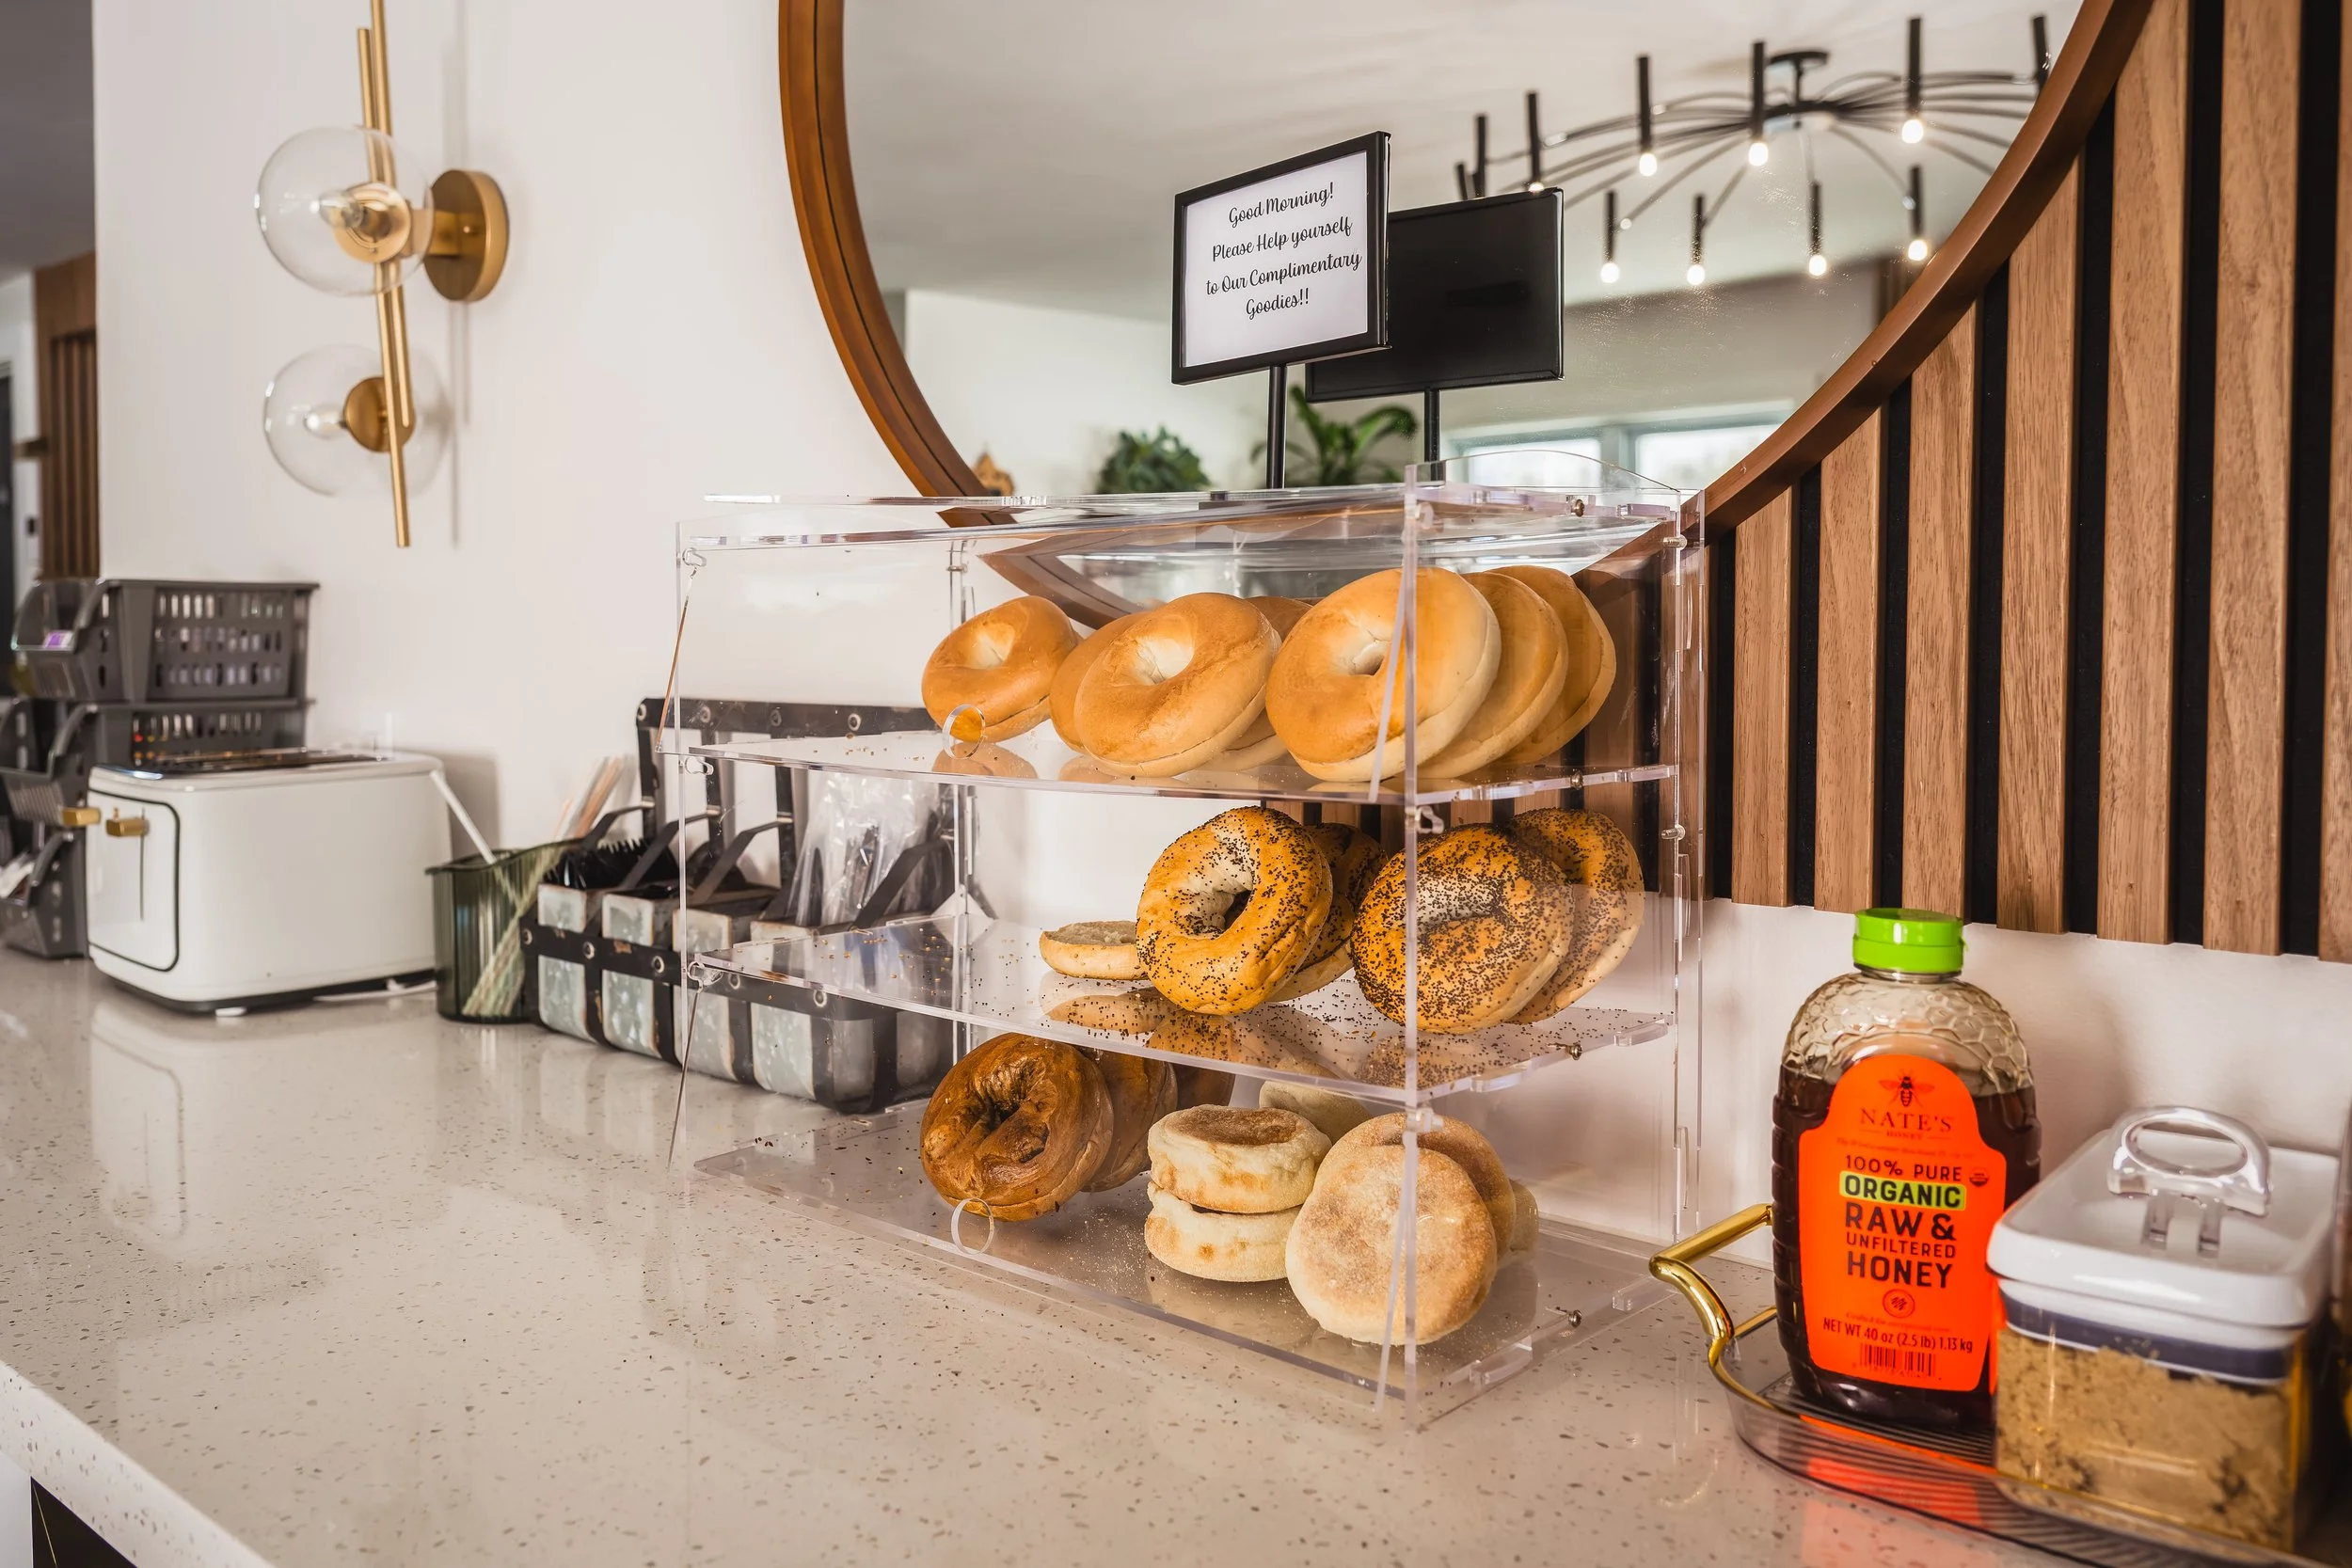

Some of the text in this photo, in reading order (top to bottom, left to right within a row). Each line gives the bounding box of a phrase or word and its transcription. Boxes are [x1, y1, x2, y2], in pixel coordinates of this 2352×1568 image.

[1229, 182, 1334, 229] Good Morning!
[1213, 216, 1353, 262] Please Help yourself
[1206, 250, 1362, 295] to Our Complimentary
[1246, 288, 1310, 320] Goodies!!
[1860, 1107, 1955, 1132] NATE'S
[1886, 1131, 1924, 1142] HONEY
[1846, 1154, 1903, 1176] 100%
[1914, 1164, 1963, 1181] PURE
[1844, 1175, 1962, 1209] ORGANIC
[1845, 1202, 1957, 1242] RAW &
[1846, 1232, 1956, 1259] UNFILTERED
[1847, 1250, 1953, 1289] HONEY
[1822, 1317, 1842, 1333] NET
[1845, 1321, 1861, 1338] WT
[1864, 1325, 1878, 1341] 40
[1881, 1332, 1894, 1344] oz
[1897, 1334, 1917, 1349] (2.5
[1920, 1336, 1936, 1351] lb)
[1939, 1337, 1958, 1352] 1.13
[1960, 1338, 1973, 1354] kg
